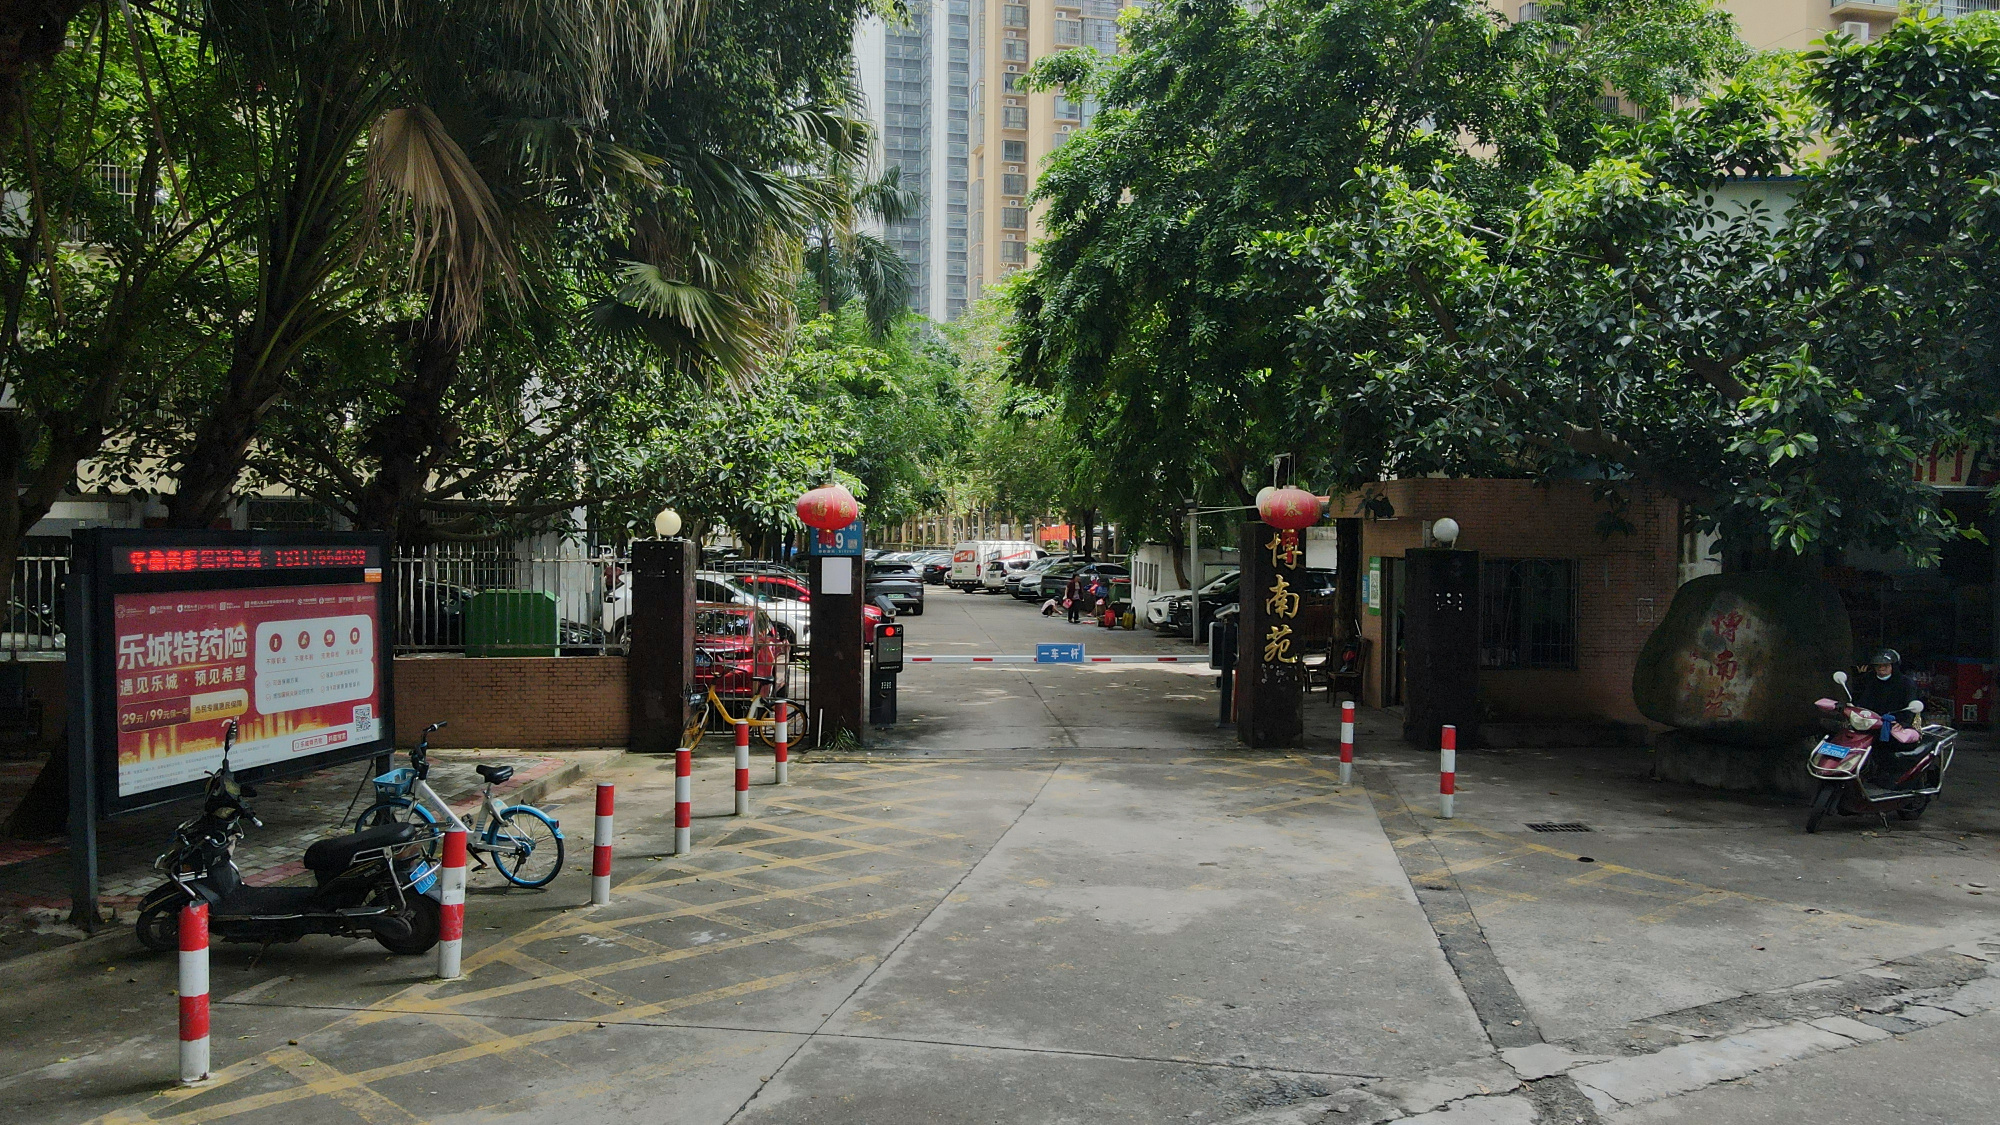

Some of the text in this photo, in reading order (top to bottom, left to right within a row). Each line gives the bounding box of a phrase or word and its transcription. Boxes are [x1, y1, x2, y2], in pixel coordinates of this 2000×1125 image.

[1264, 533, 1303, 664] 博南苑
[117, 626, 248, 670] 乐城特药险
[1040, 647, 1080, 660] 一车一杆
